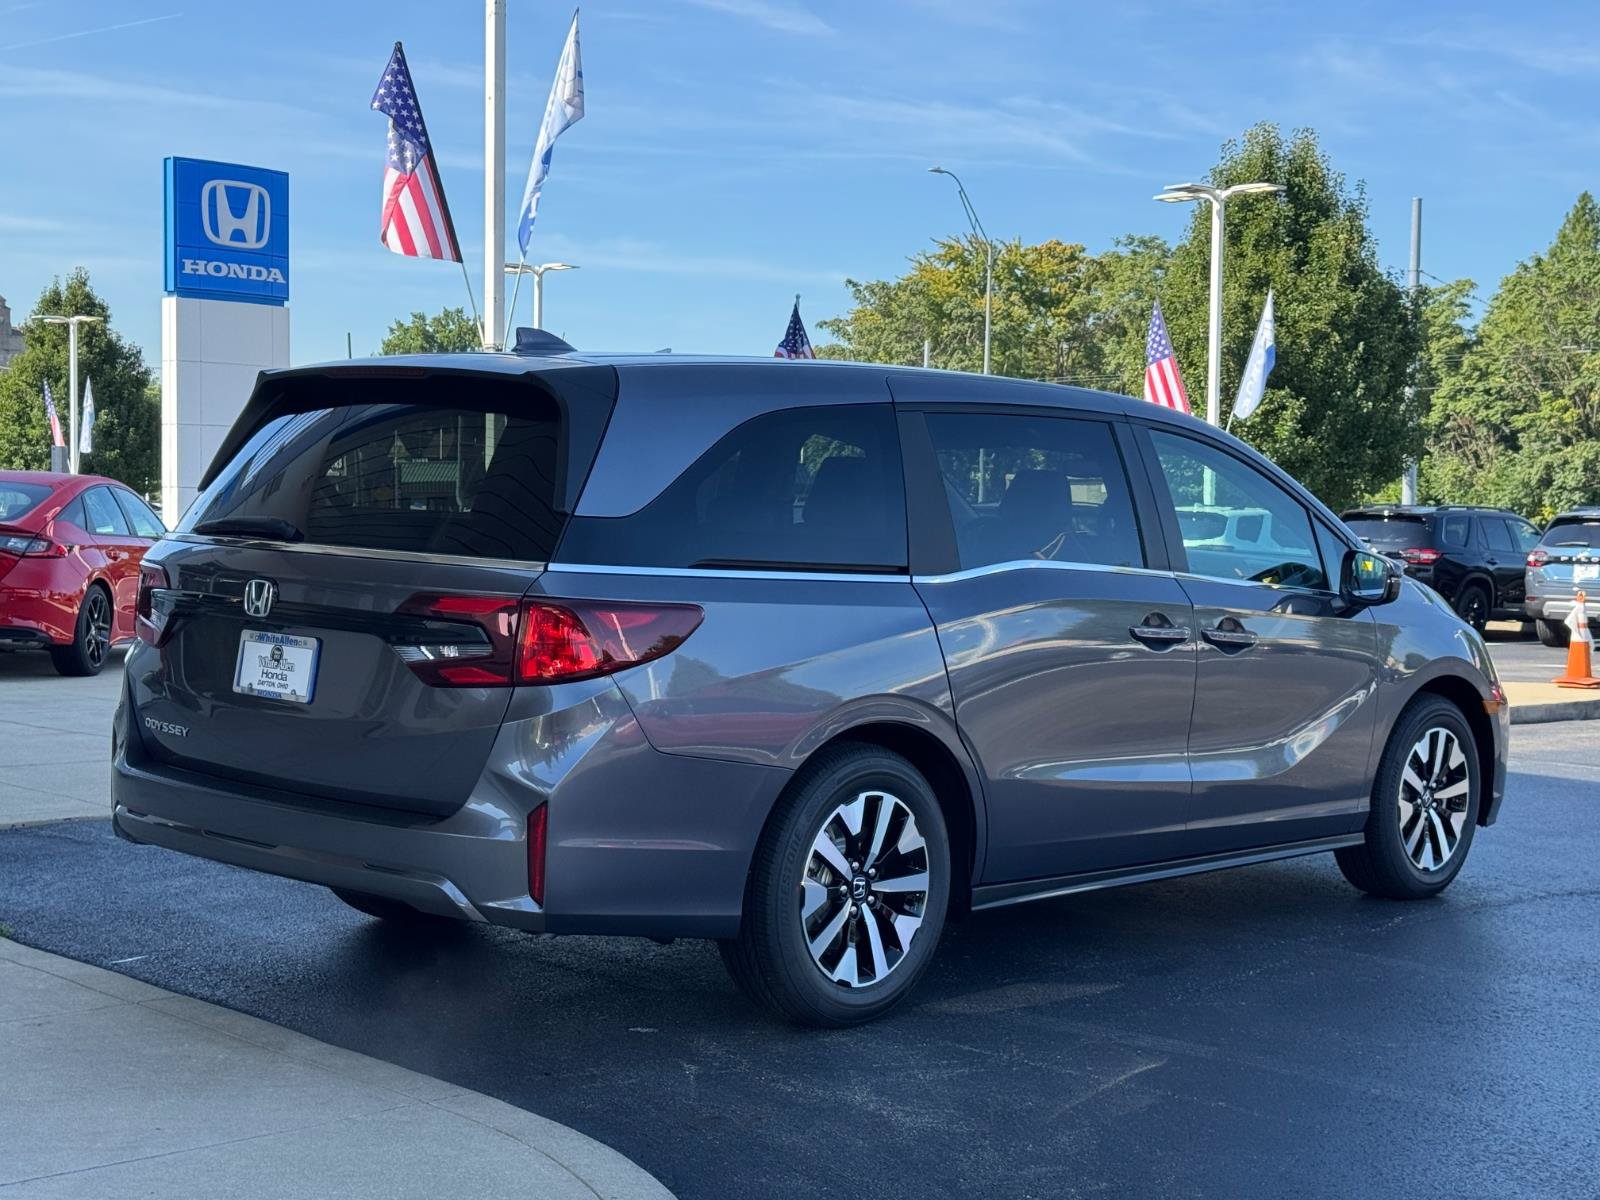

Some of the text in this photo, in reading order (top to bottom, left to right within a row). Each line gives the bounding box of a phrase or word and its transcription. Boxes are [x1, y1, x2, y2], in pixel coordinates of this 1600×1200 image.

[182, 259, 286, 284] HONDA
[261, 669, 288, 682] Honda
[145, 717, 190, 737] ODYSSEY
